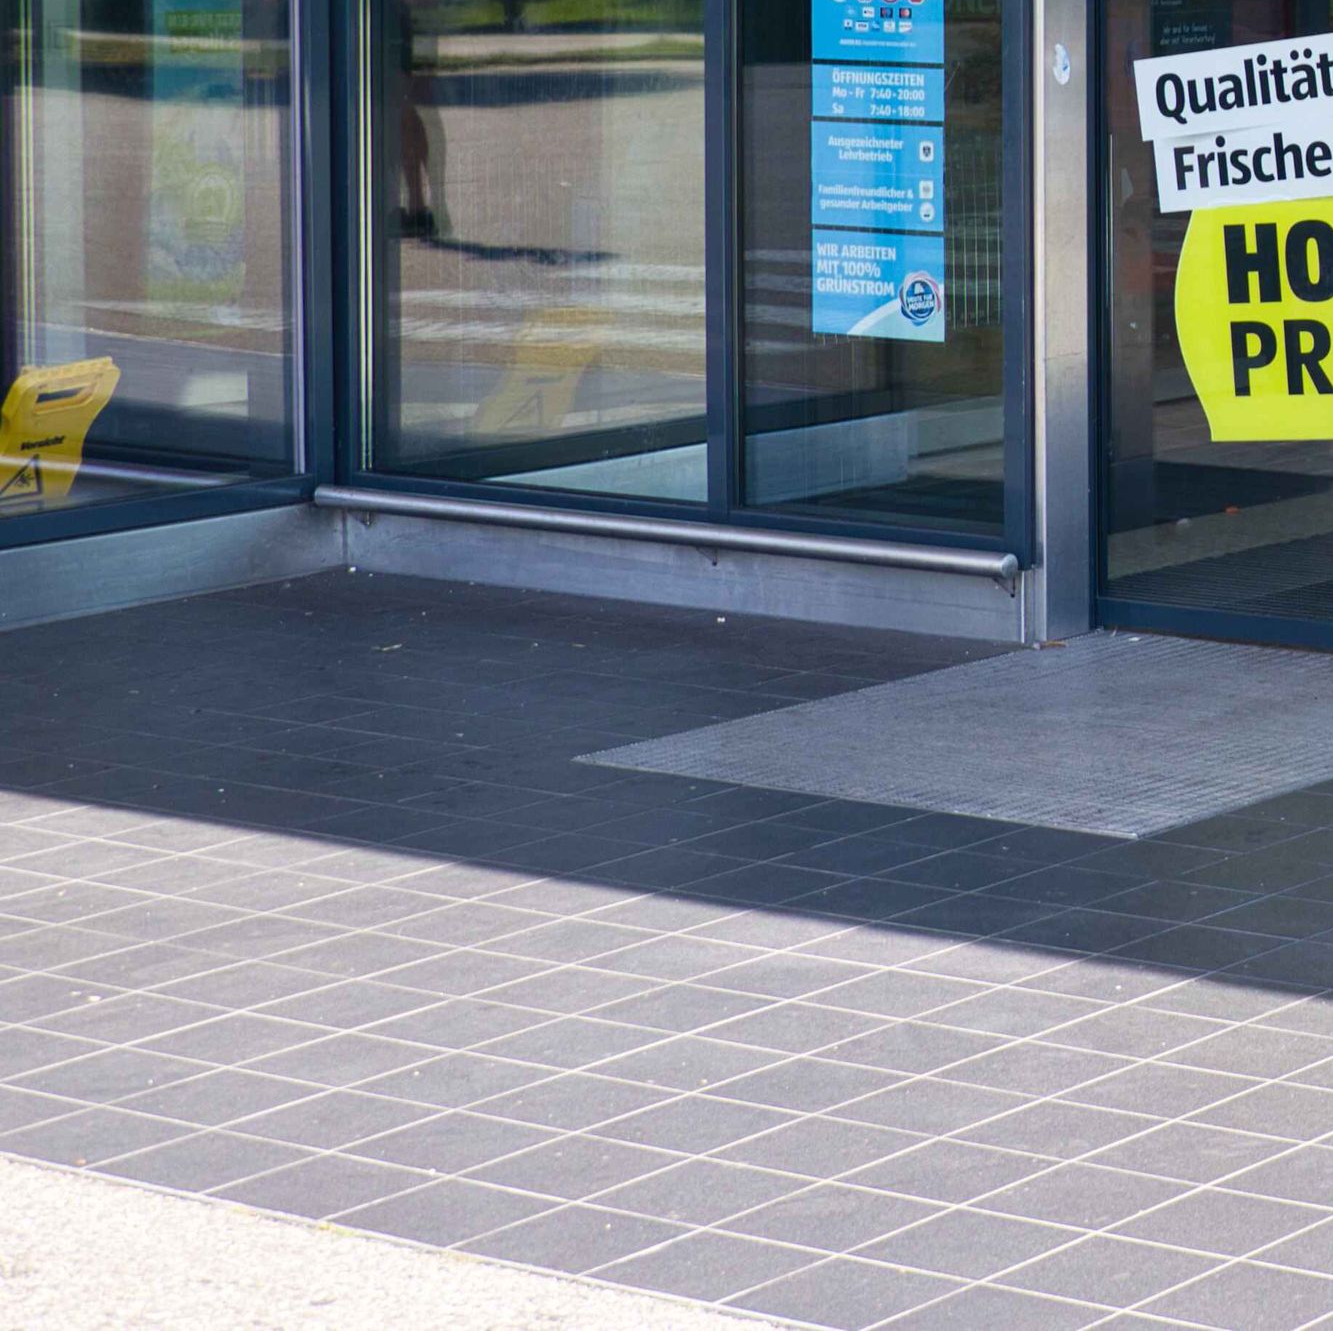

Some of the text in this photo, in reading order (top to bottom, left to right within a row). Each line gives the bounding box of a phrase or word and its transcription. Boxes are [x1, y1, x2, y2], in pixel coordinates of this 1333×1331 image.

[832, 68, 925, 87] ÖFFNUNGSZEITEN
[832, 87, 847, 97] Mo
[855, 87, 865, 98] Fr
[832, 102, 844, 113] Sa
[1173, 131, 1333, 191] Frische
[816, 243, 896, 261] WIR ARBEITEN
[816, 260, 881, 277] MIT 100%
[816, 274, 895, 296] GRÜNSTROM
